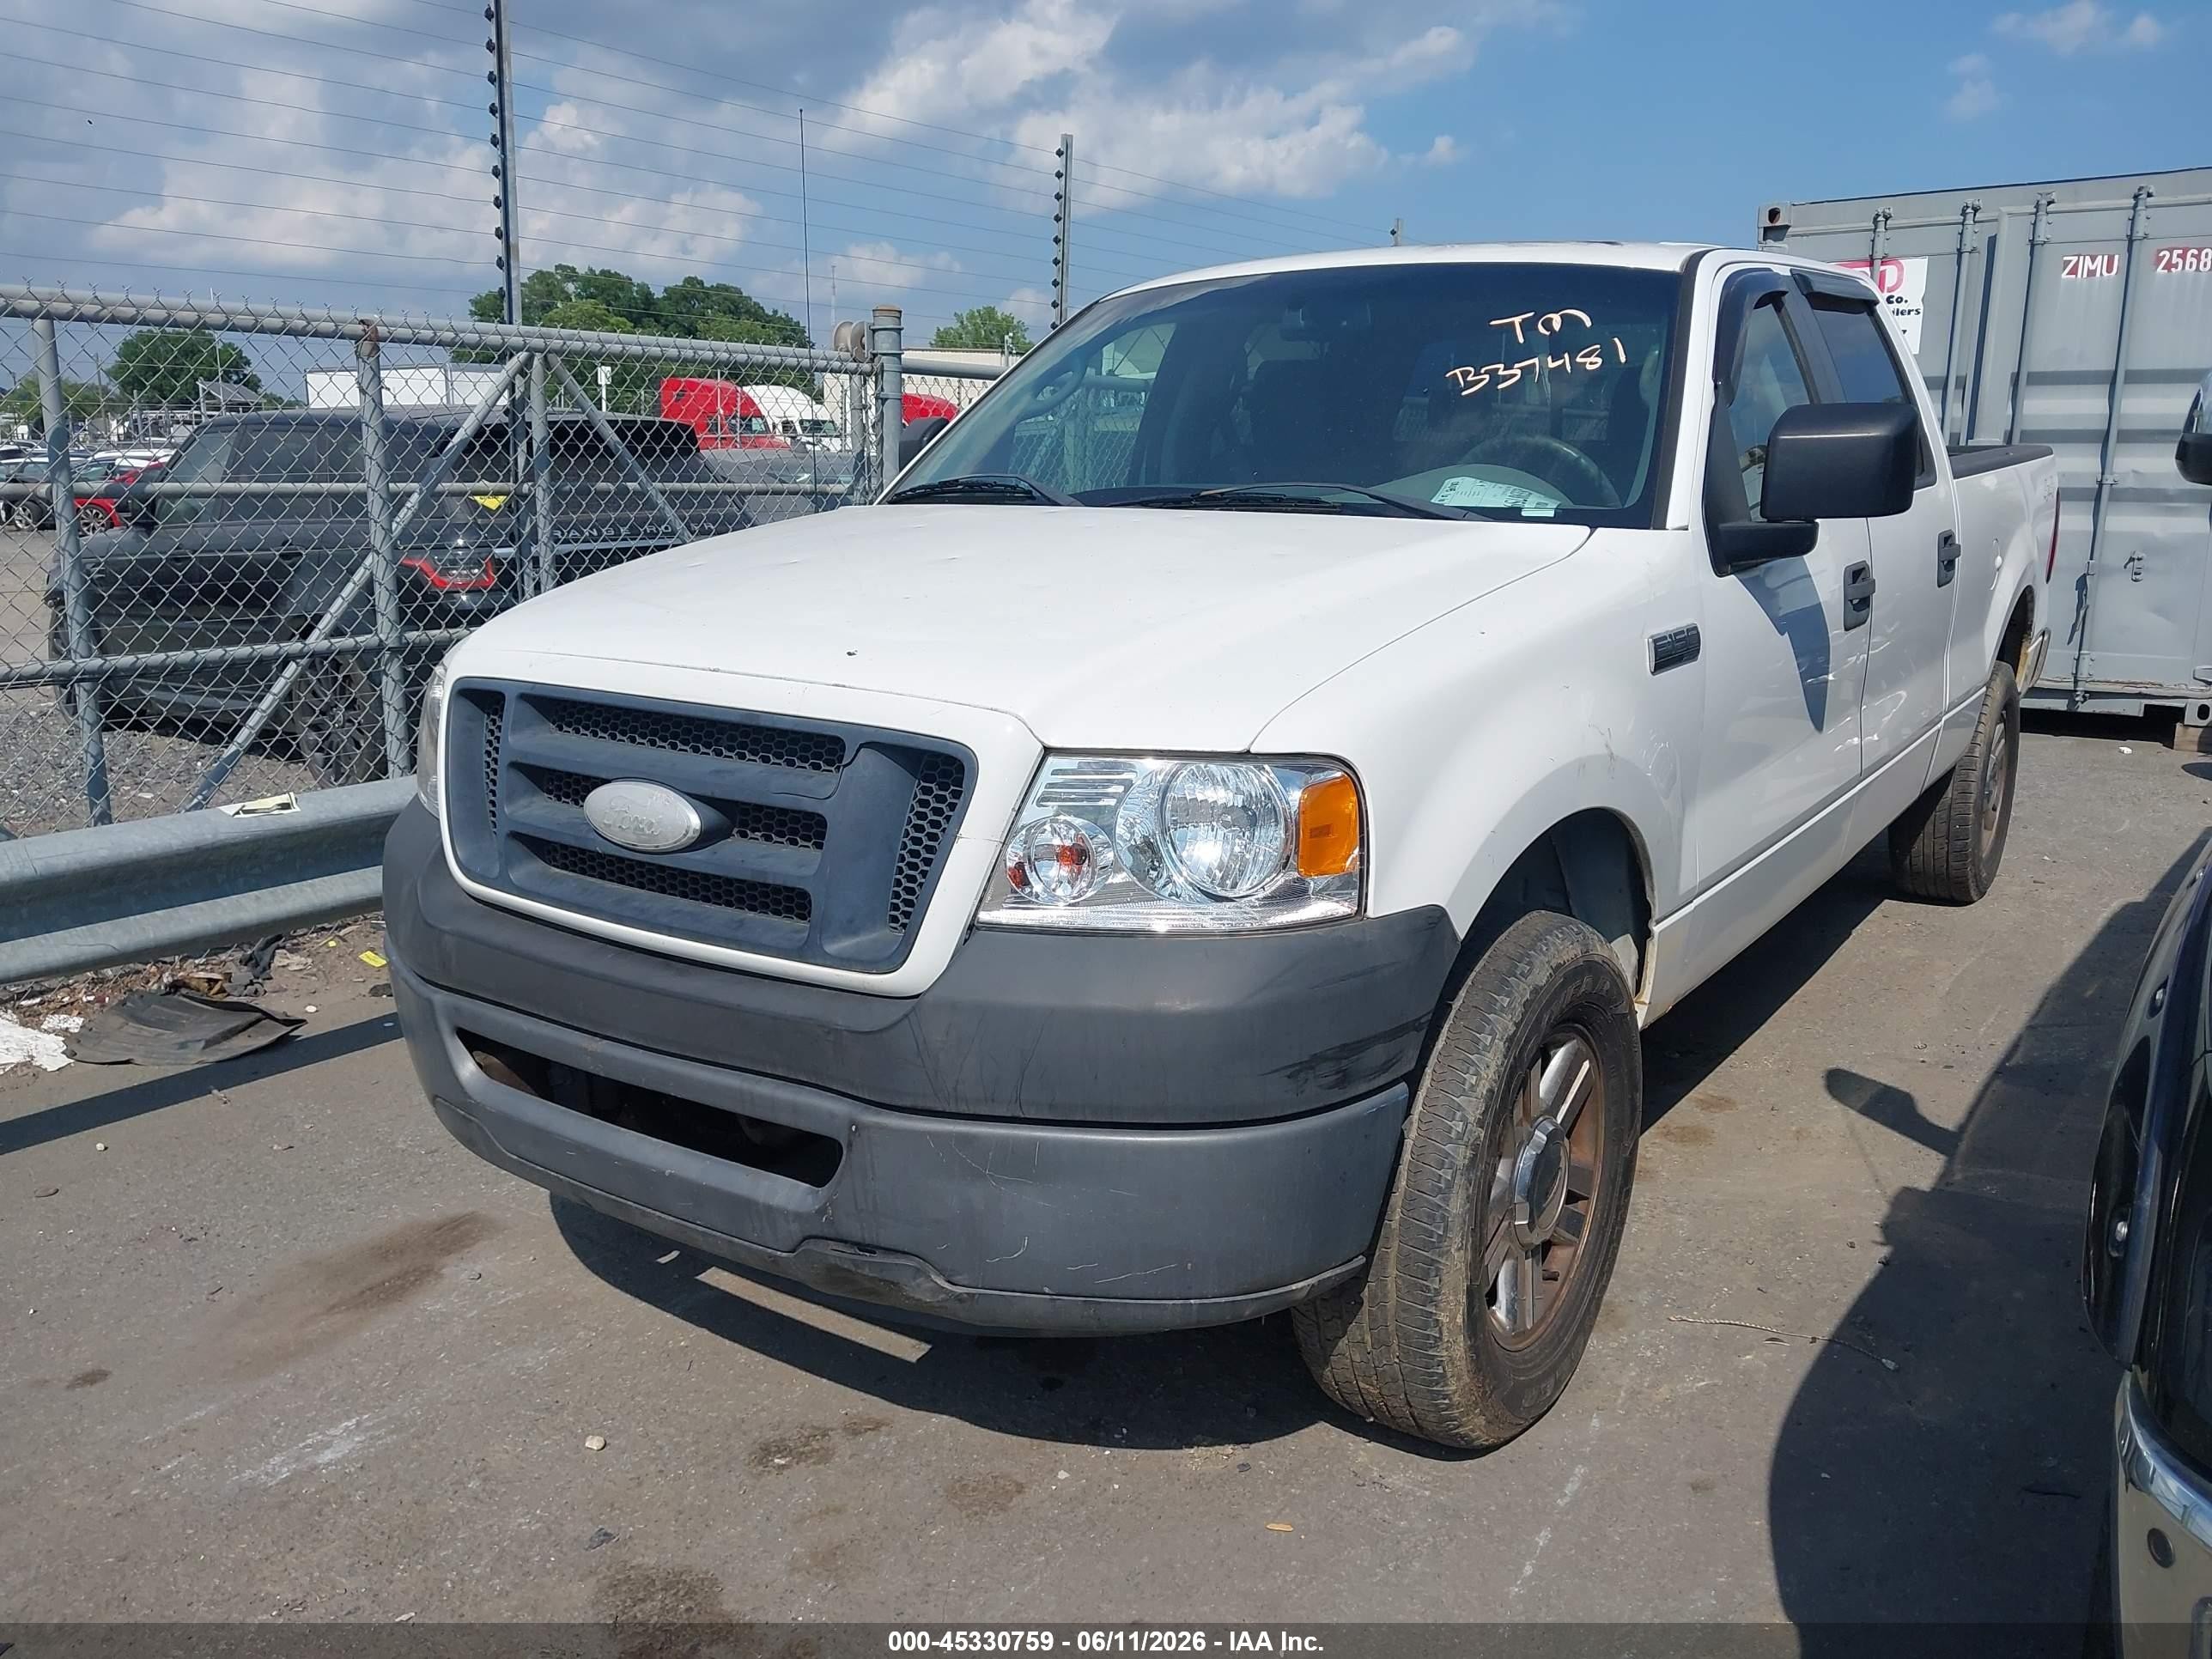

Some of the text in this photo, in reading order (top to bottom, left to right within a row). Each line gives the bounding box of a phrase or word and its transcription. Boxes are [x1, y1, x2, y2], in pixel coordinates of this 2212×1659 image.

[2062, 247, 2212, 278] ZIMU 2568
[1886, 295, 1908, 304] Co.
[646, 522, 714, 533] ROER
